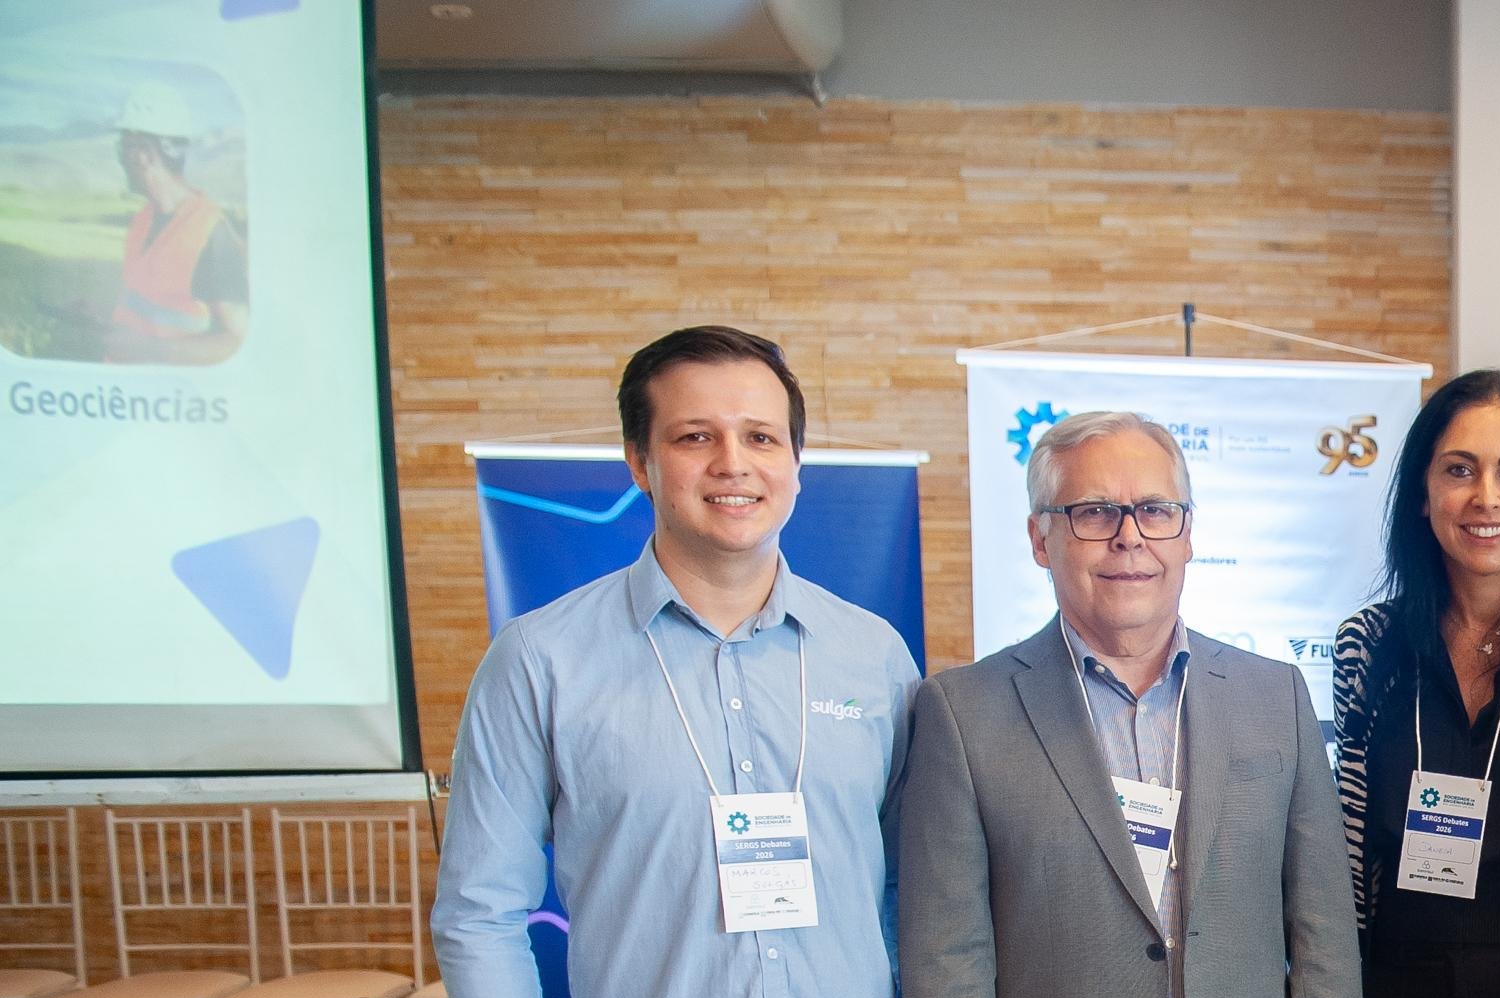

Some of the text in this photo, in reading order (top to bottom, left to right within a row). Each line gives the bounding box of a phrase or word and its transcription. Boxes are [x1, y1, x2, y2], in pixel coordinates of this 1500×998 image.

[9, 380, 229, 423] Geociências
[1317, 415, 1378, 475] 95
[1421, 814, 1469, 827] SERGS Debates
[1435, 825, 1452, 833] 2026
[735, 840, 792, 850] SERGS Debates
[755, 851, 774, 859] 2026
